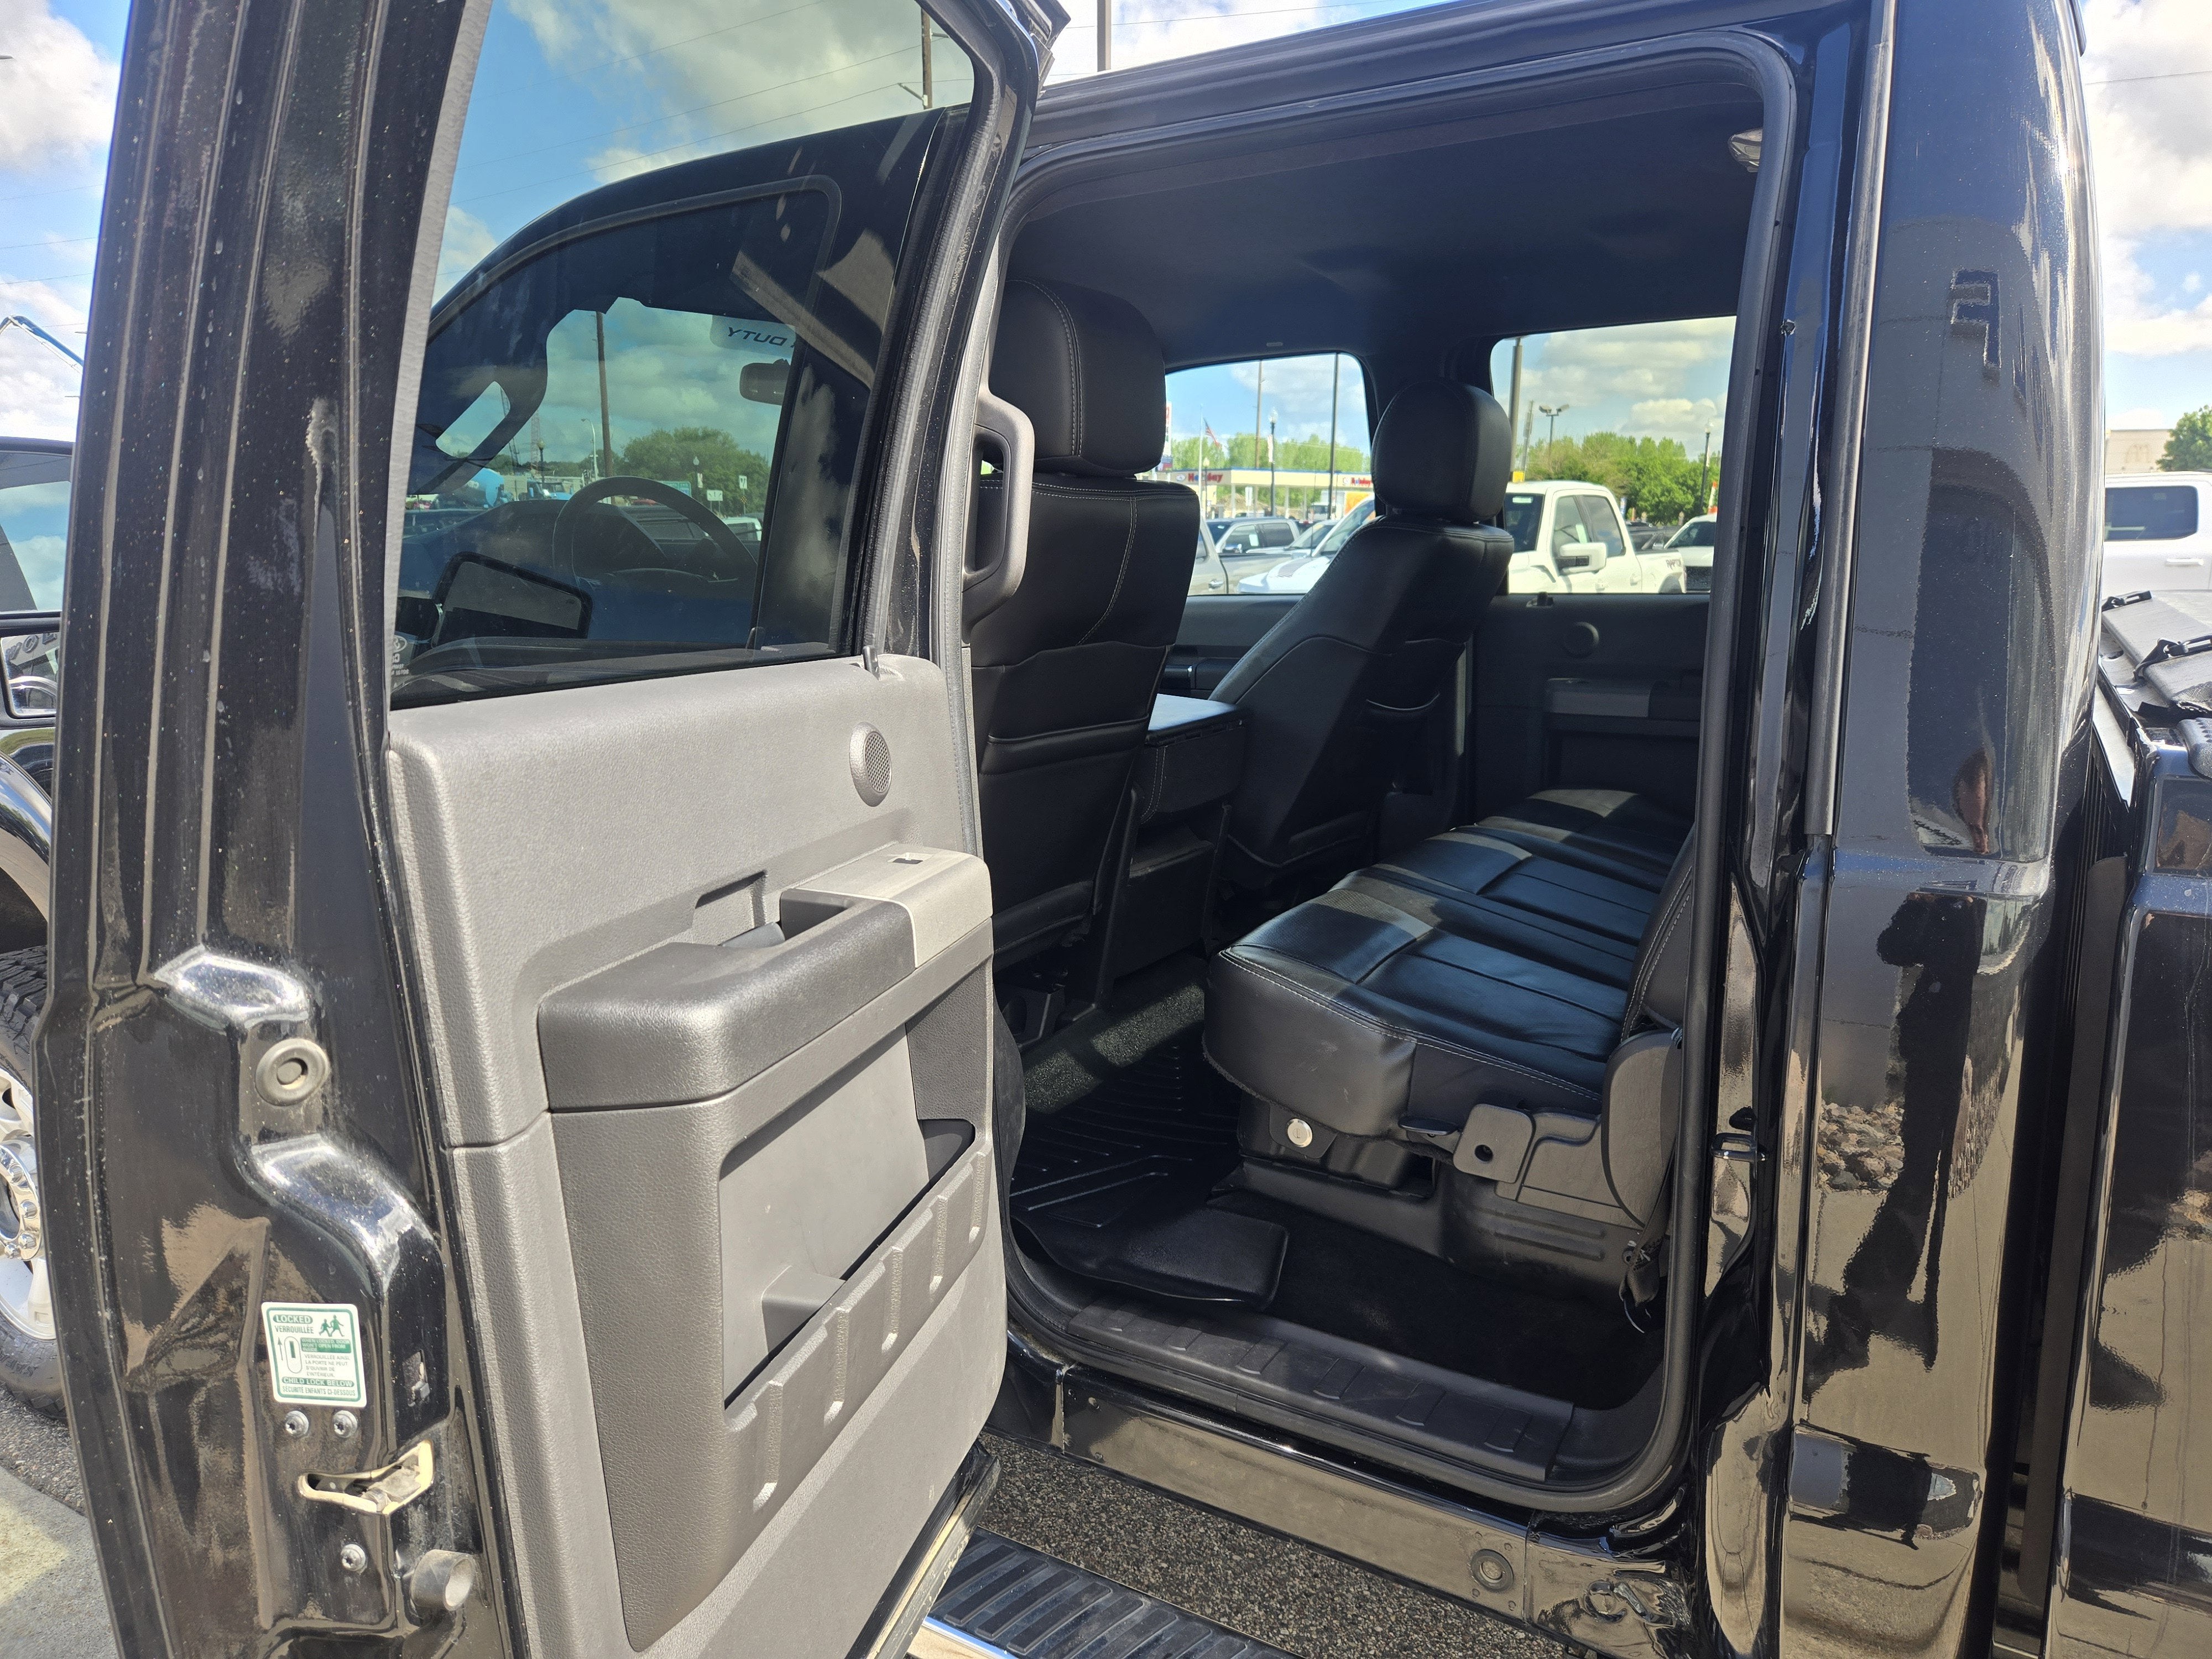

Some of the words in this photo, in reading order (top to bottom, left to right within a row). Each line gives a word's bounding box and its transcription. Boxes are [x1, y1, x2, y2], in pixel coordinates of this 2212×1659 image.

[1188, 472, 1223, 483] Hoday
[275, 1314, 311, 1323] LOCKED
[274, 1324, 314, 1334] VERROUILLÉE
[282, 1385, 304, 1393] SÉCURITÉ
